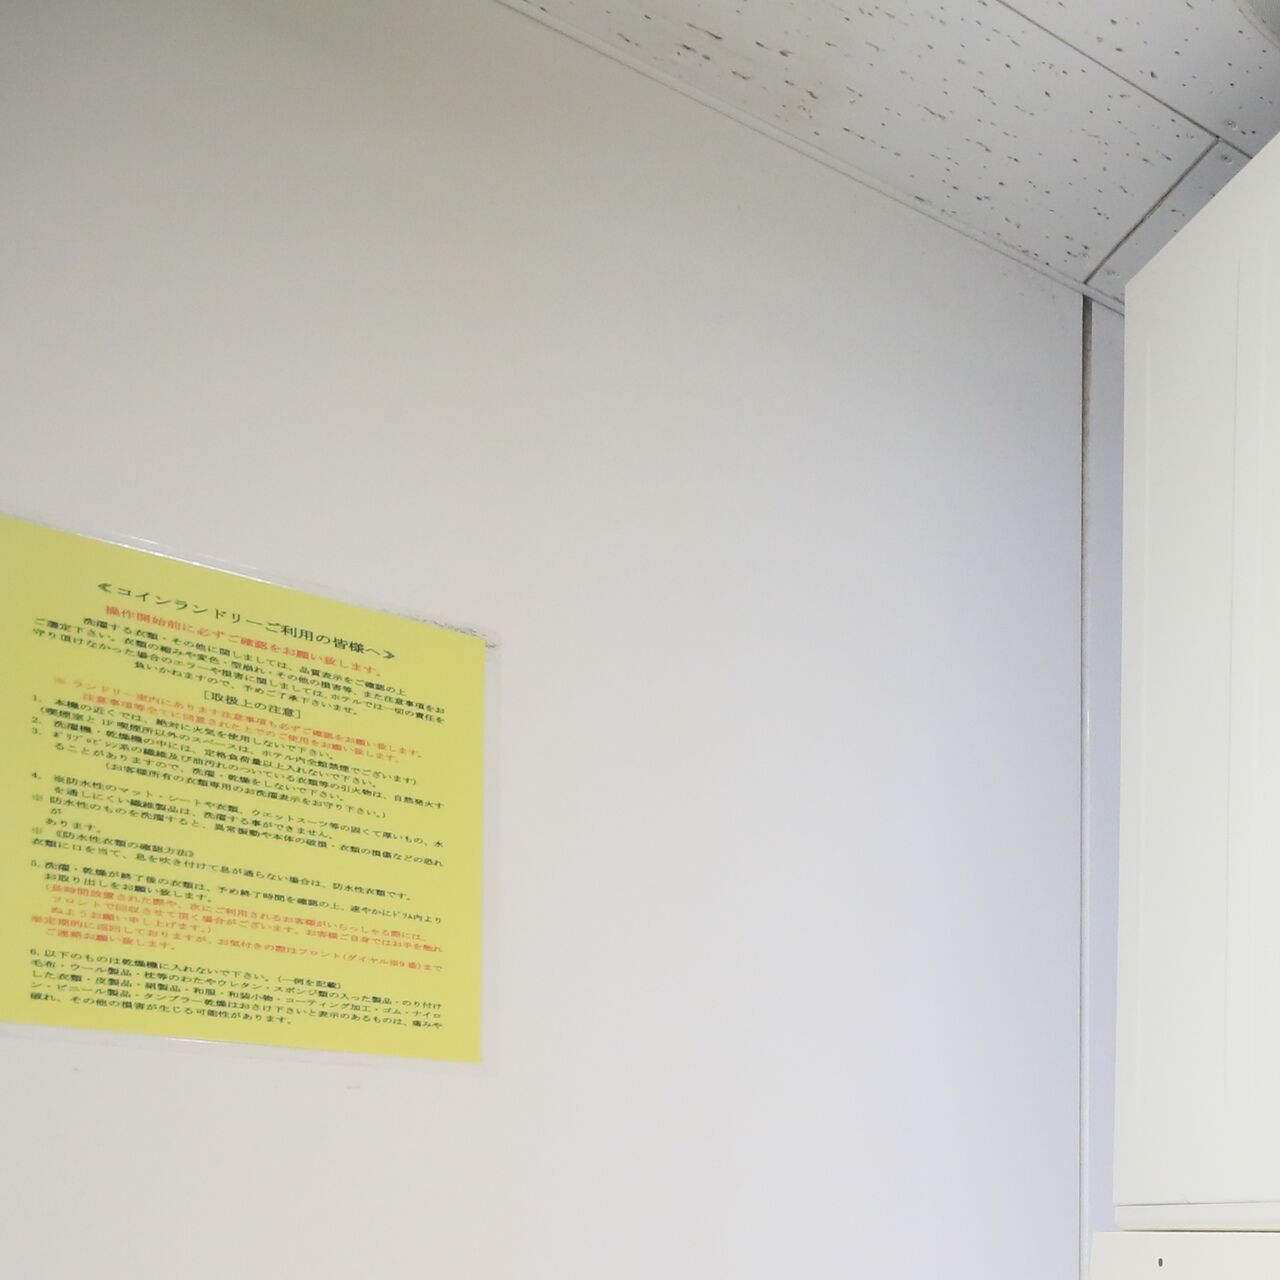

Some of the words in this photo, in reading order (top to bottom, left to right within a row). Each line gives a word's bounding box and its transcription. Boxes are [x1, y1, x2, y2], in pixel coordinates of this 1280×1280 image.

[105, 604, 381, 677] 操作開始前に必ずご確認をお願い致します。
[203, 689, 301, 719] [取扱上の注意]
[53, 697, 334, 760] 本機の近くでは、絶対に火気を使用しないで下さい。
[44, 817, 102, 833] あります。
[43, 871, 212, 902] お取り出しをお願い致します。
[45, 927, 176, 950] ご連絡お願い致します。
[29, 991, 292, 1024] 破れ、その他の損害が生じる可能性があります。
